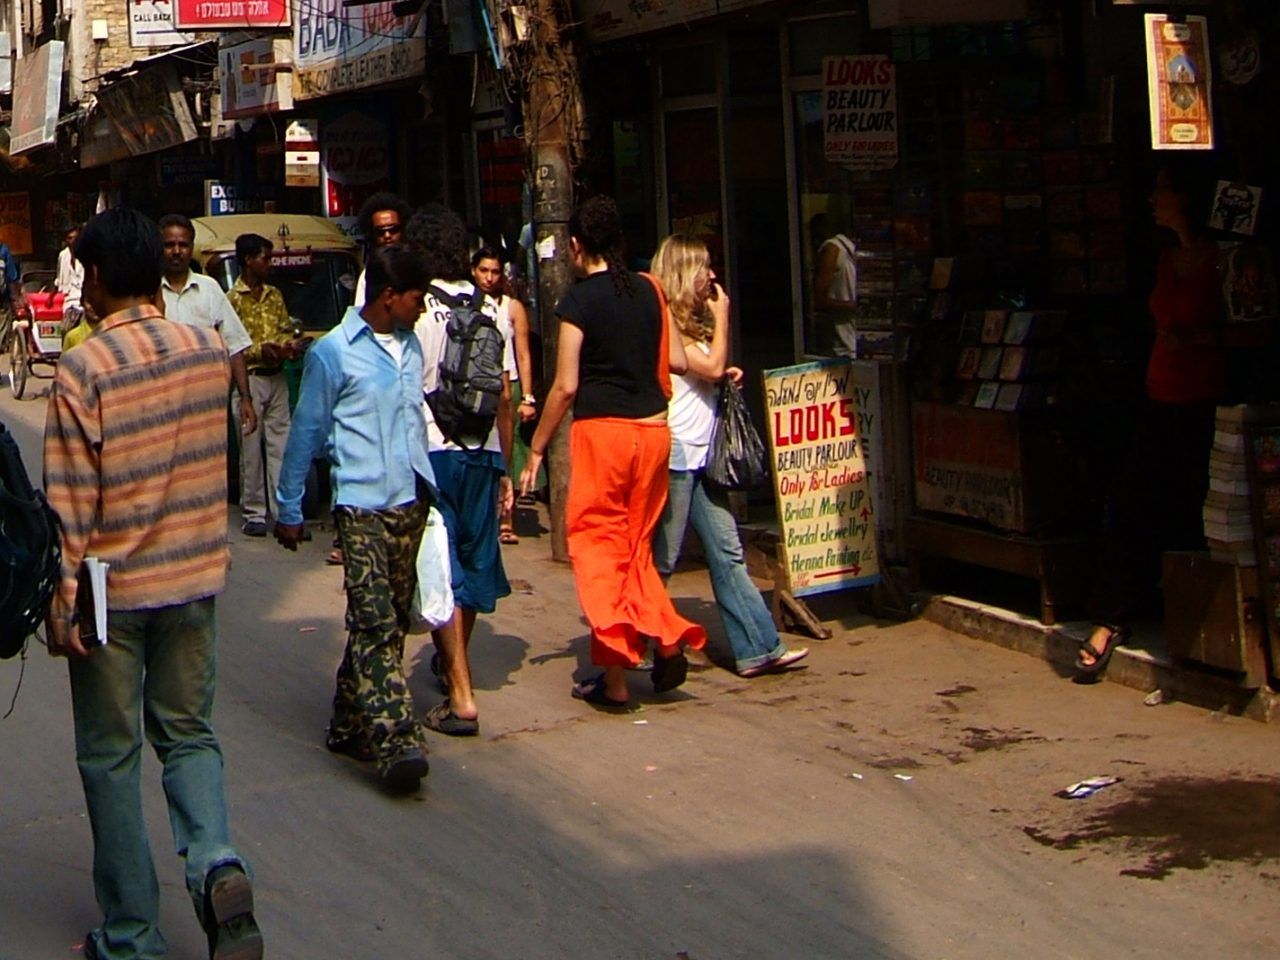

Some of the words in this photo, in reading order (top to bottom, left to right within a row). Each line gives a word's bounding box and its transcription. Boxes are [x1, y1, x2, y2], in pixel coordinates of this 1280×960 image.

[134, 14, 151, 22] CALL
[827, 60, 891, 85] LOOKS
[827, 89, 891, 109] BEAUTY
[827, 111, 894, 133] PARLOUR
[774, 398, 855, 447] LOOKS
[778, 446, 812, 472] BEAUTY
[816, 439, 858, 465] PARLOUR
[780, 473, 805, 499] Only
[825, 464, 863, 488] Ladies
[785, 499, 815, 523] Bridal
[819, 492, 846, 517] Make
[850, 490, 865, 511] UP
[787, 524, 818, 548] Bridal
[791, 553, 824, 572] Henna
[826, 546, 860, 568] Painting
